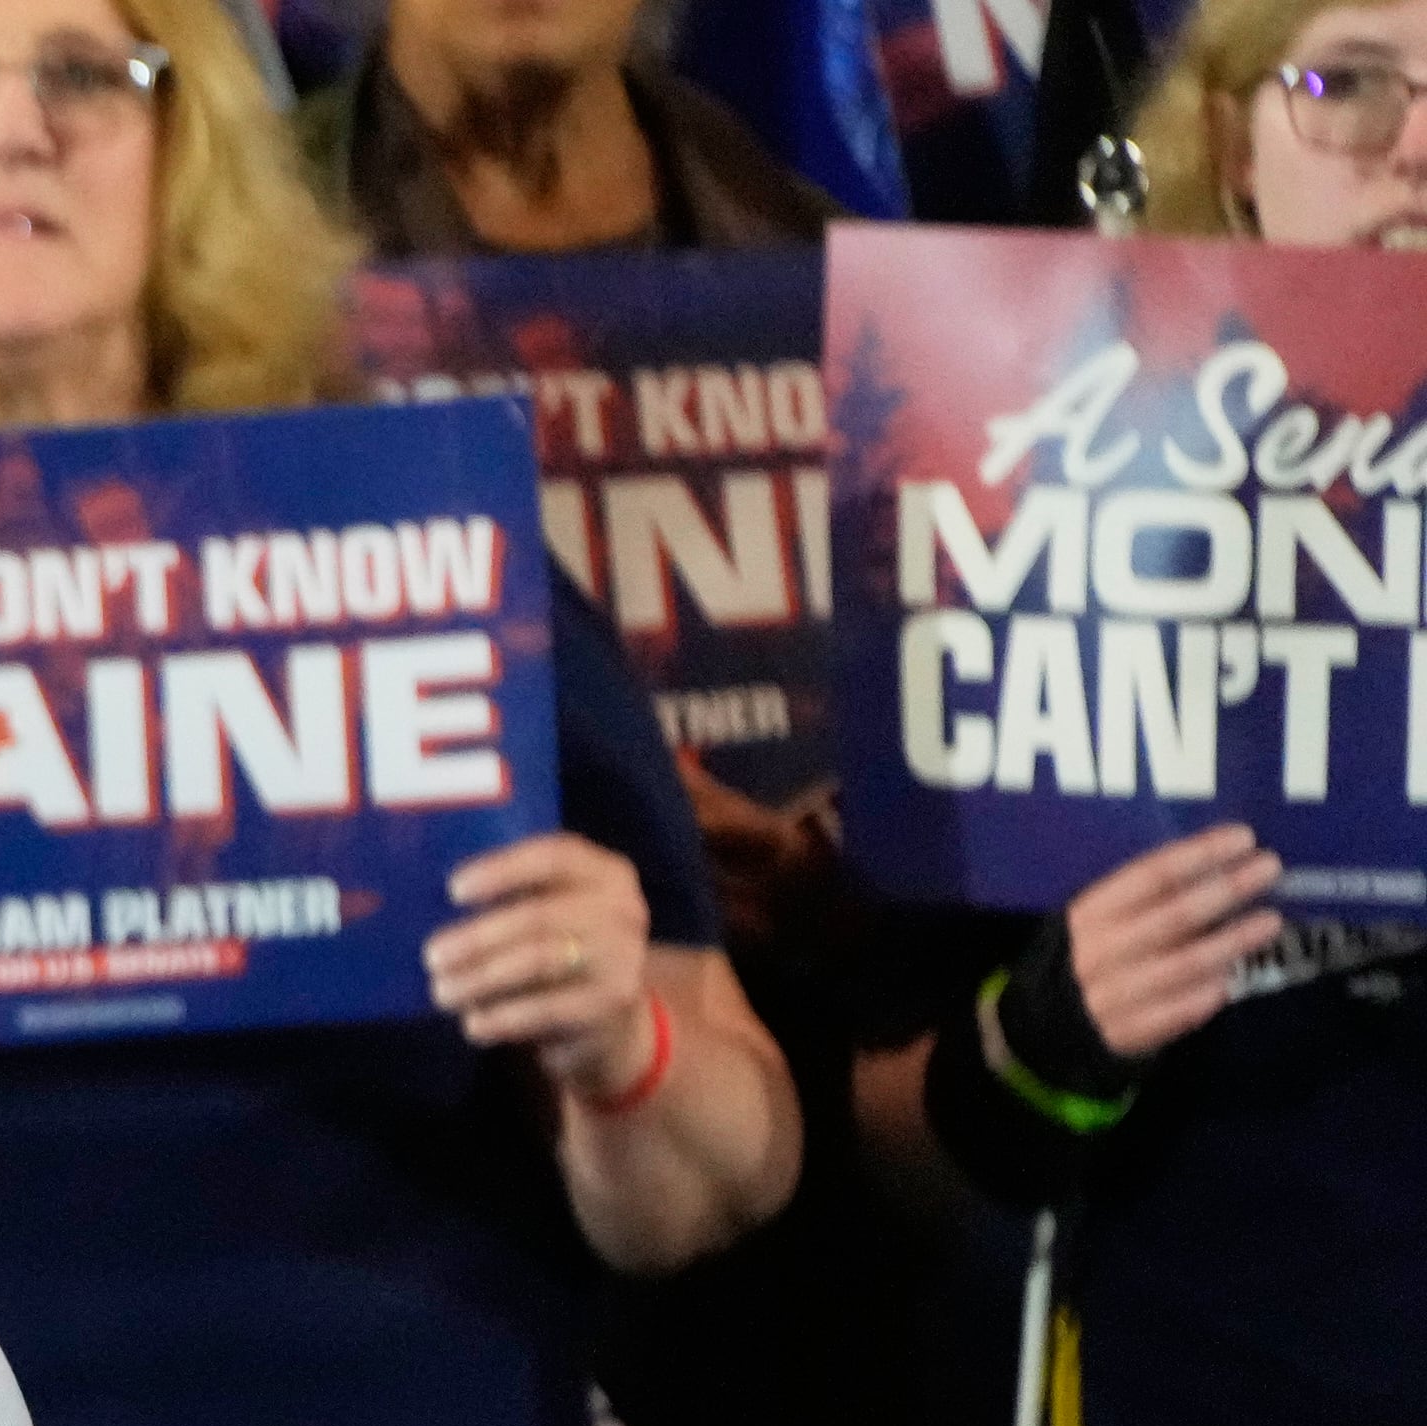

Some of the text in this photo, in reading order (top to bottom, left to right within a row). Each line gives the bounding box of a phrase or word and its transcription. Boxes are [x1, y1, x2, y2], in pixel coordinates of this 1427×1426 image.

[977, 338, 1141, 488] A
[202, 513, 504, 629] KNOW
[896, 480, 1427, 628] MON
[898, 608, 1359, 802] CAN'T
